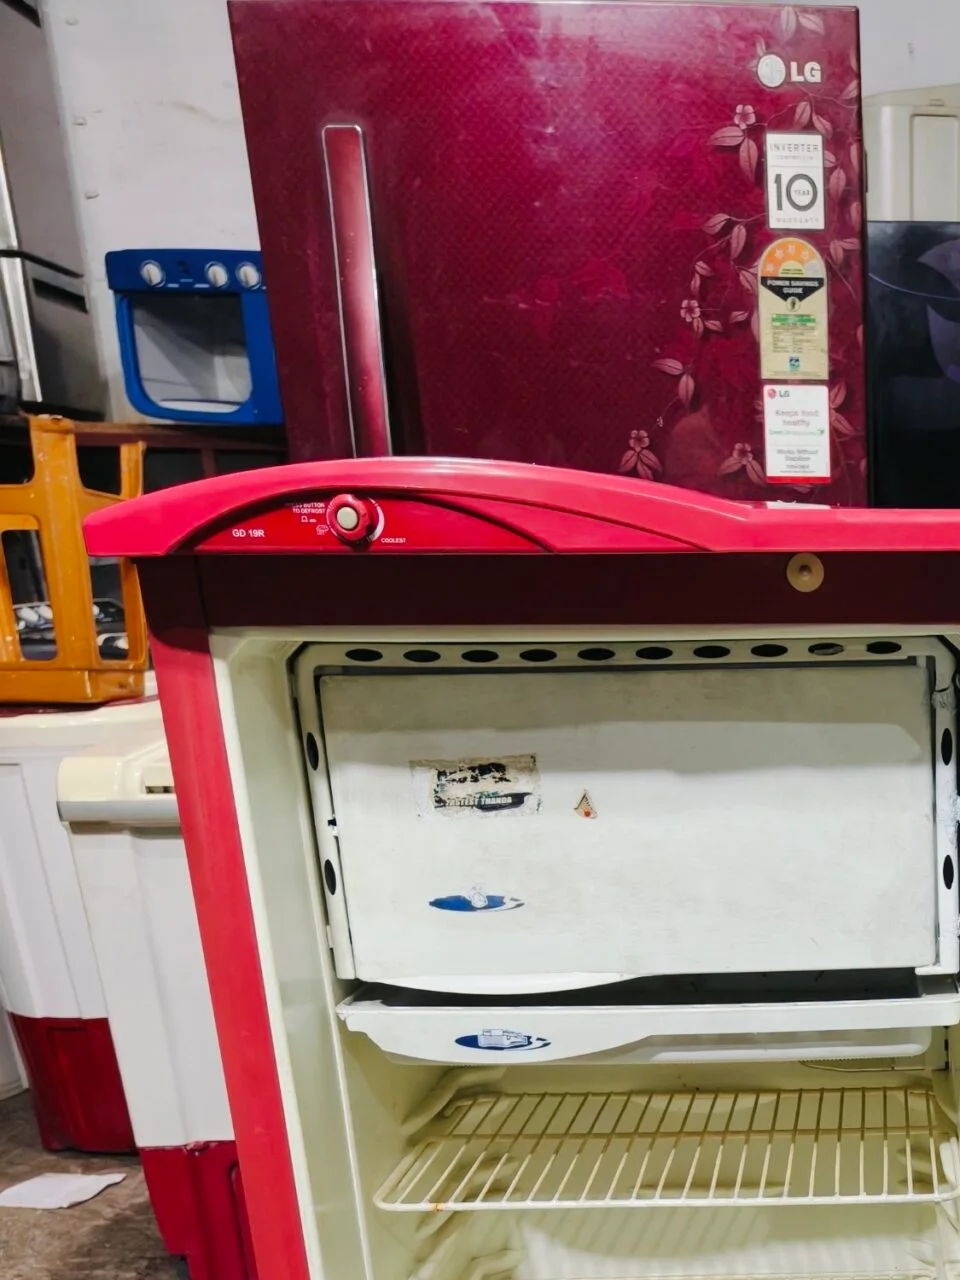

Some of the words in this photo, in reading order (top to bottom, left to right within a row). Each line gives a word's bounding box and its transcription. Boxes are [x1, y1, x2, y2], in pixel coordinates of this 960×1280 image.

[790, 61, 822, 83] LG
[769, 143, 820, 153] INVERTER
[774, 173, 818, 212] 10
[794, 189, 811, 197] YEAR
[778, 390, 791, 398] LG
[232, 528, 246, 538] GD
[248, 528, 266, 538] 19R
